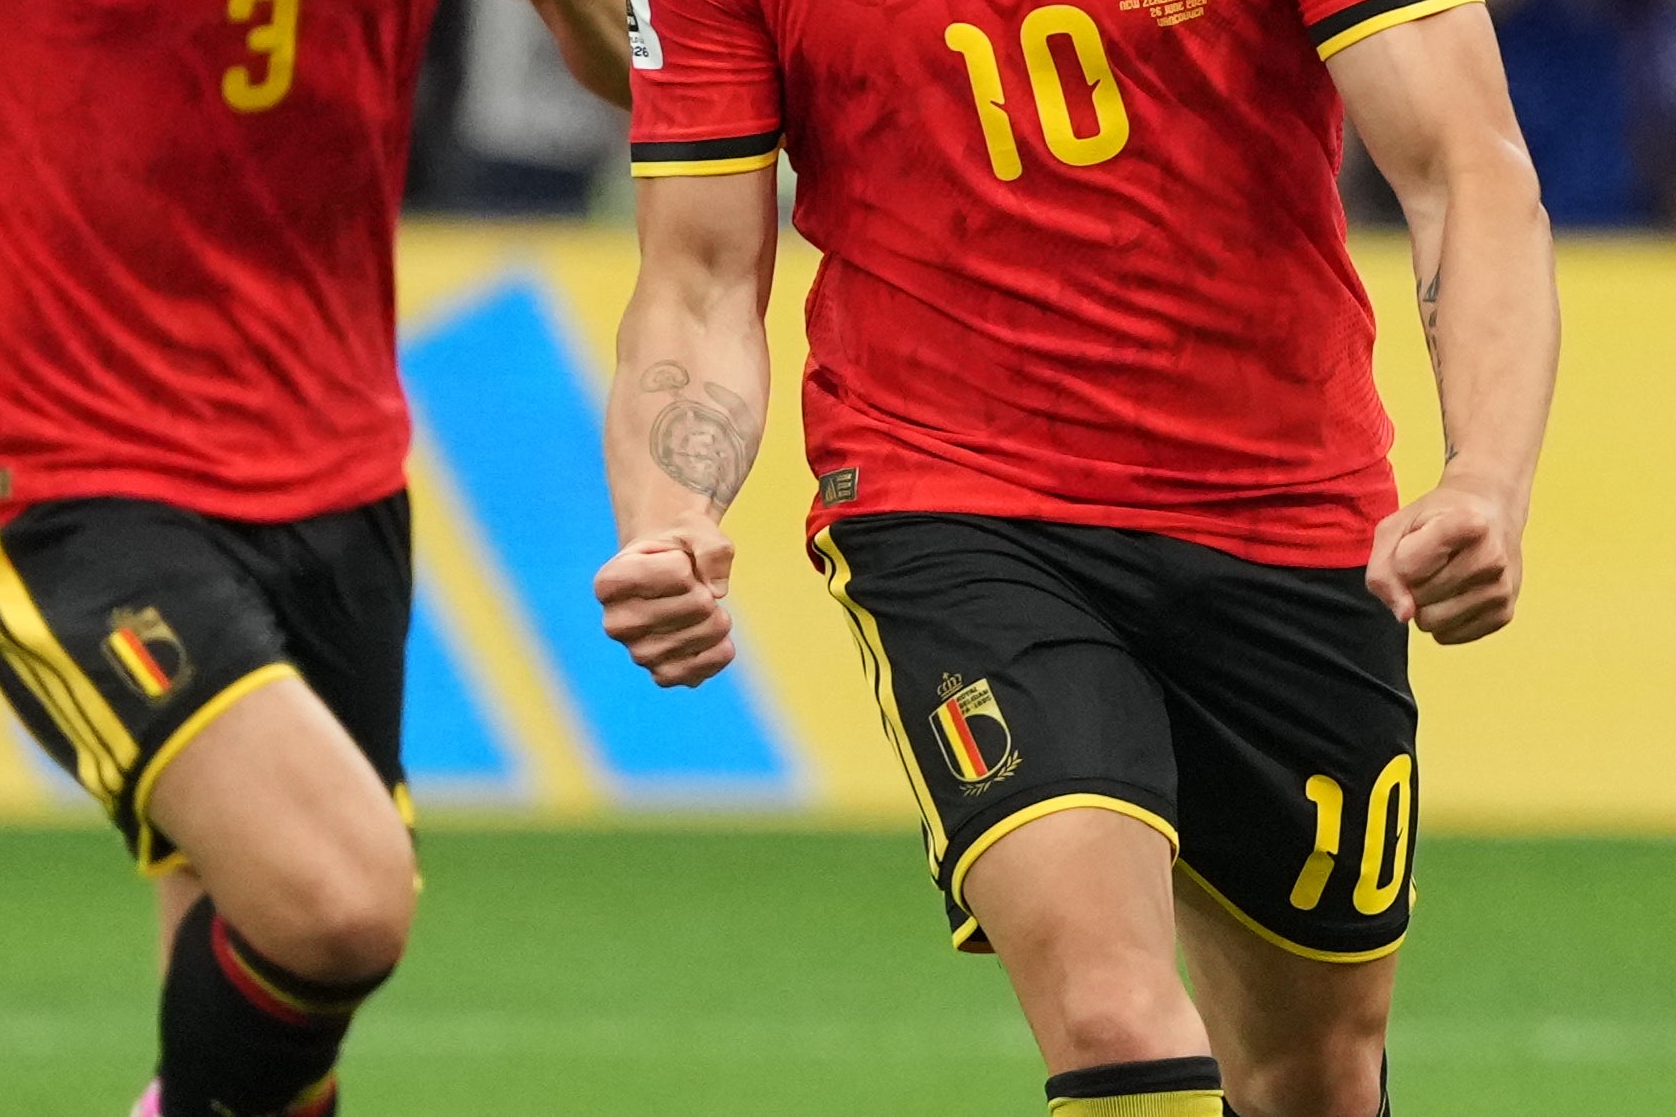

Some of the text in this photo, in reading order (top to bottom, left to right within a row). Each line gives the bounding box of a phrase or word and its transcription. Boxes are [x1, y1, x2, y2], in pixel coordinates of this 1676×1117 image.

[1119, 0, 1140, 11] NEW
[1150, 6, 1163, 18] 26
[944, 4, 1129, 181] 10
[1289, 753, 1412, 915] 10
